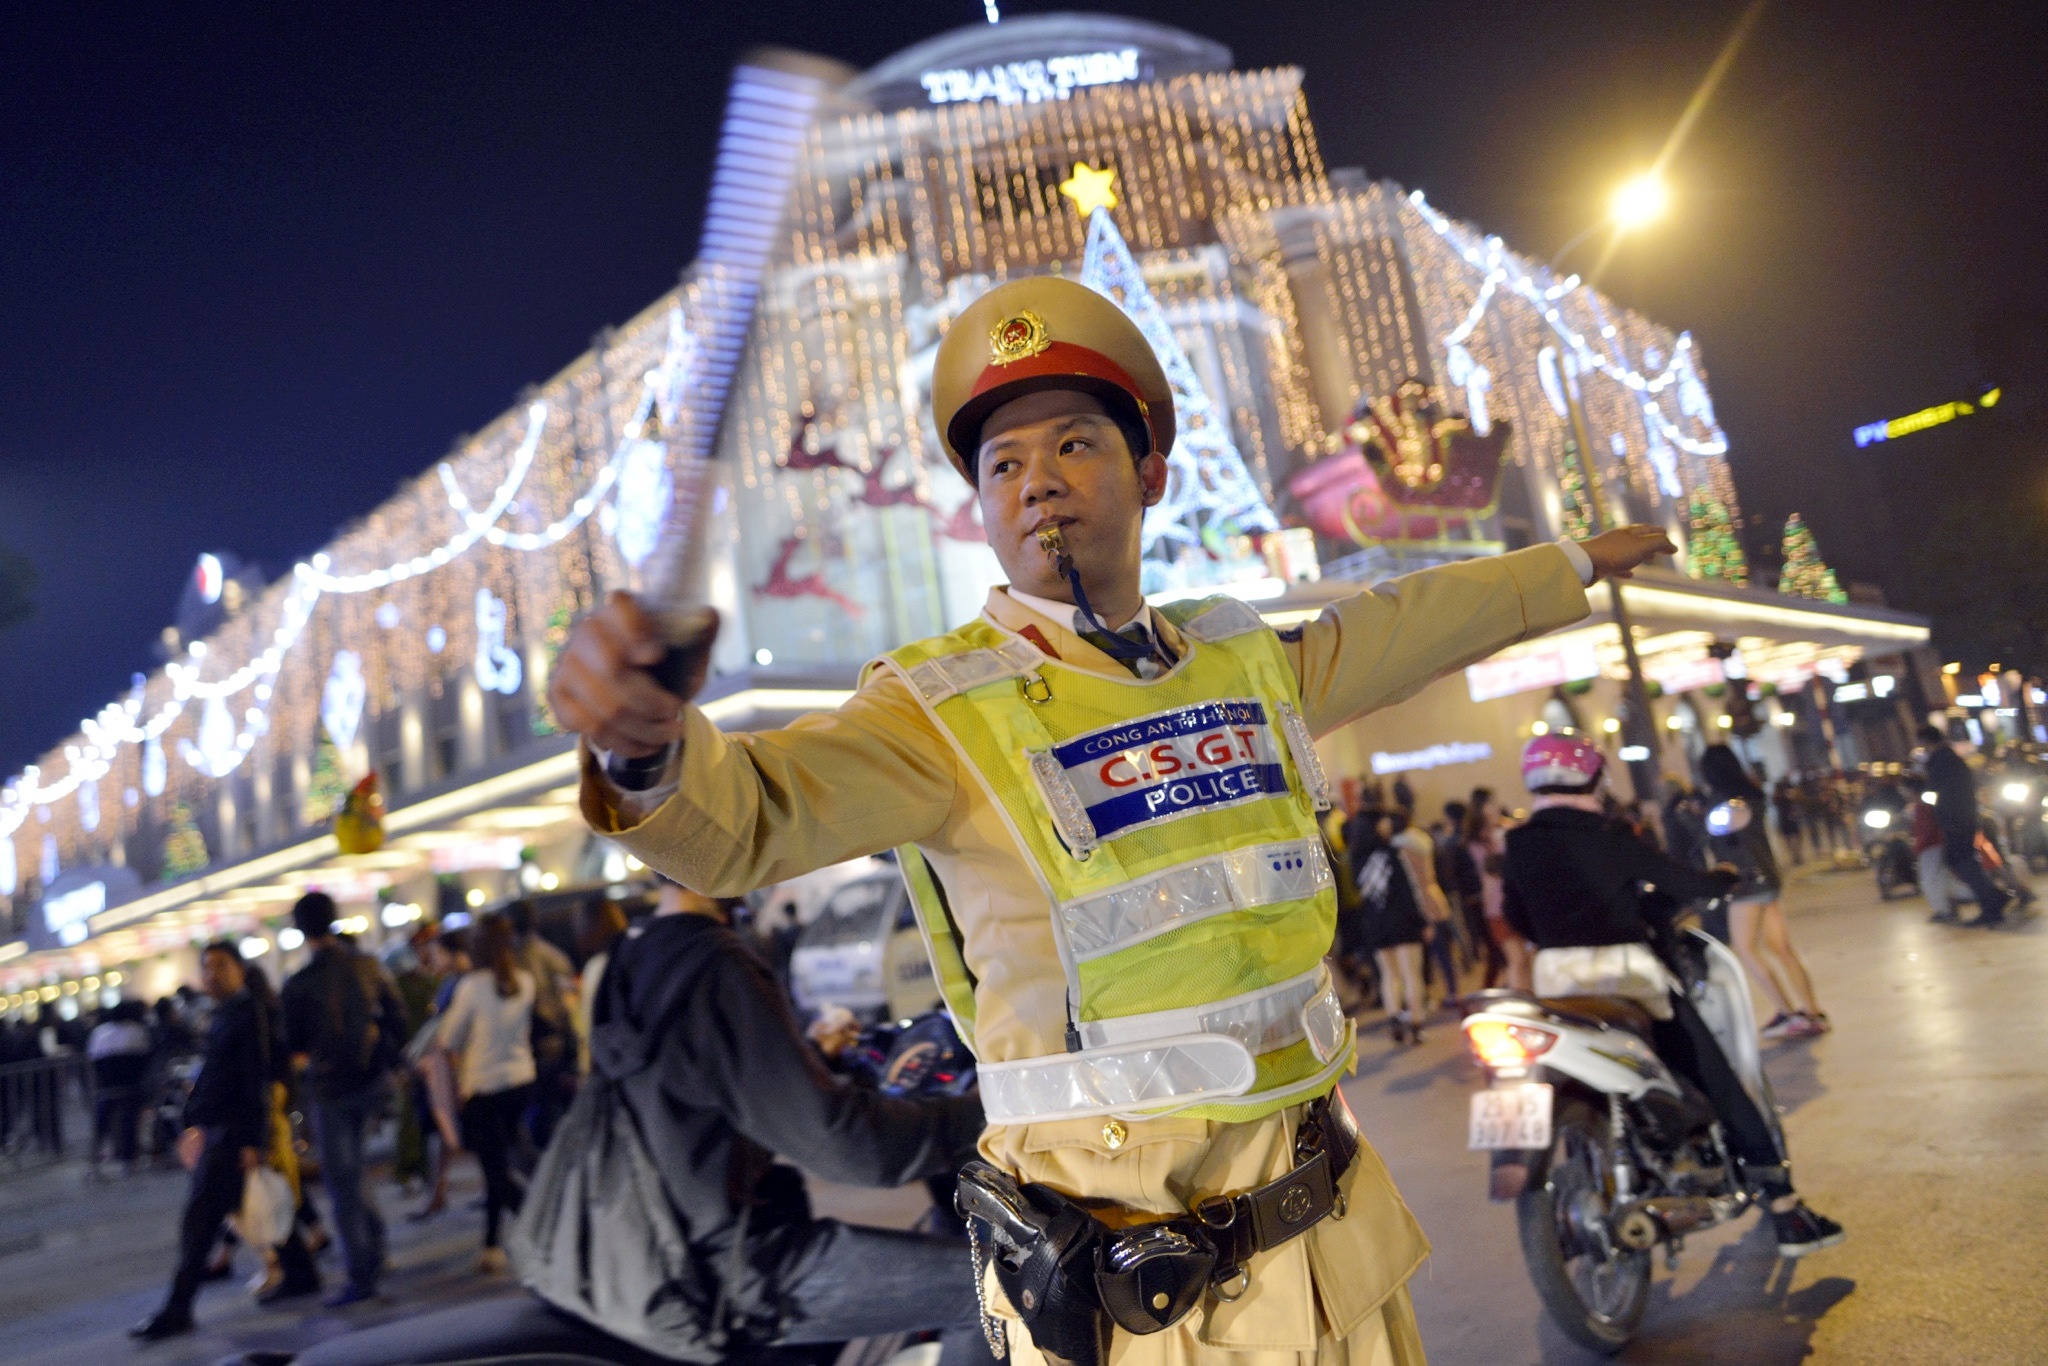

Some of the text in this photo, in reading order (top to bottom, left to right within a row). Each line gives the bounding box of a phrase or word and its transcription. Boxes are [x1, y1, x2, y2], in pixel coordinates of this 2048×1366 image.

[1084, 728, 1142, 754] CÔNG
[1147, 721, 1173, 737] AN
[1145, 769, 1259, 812] POLICE
